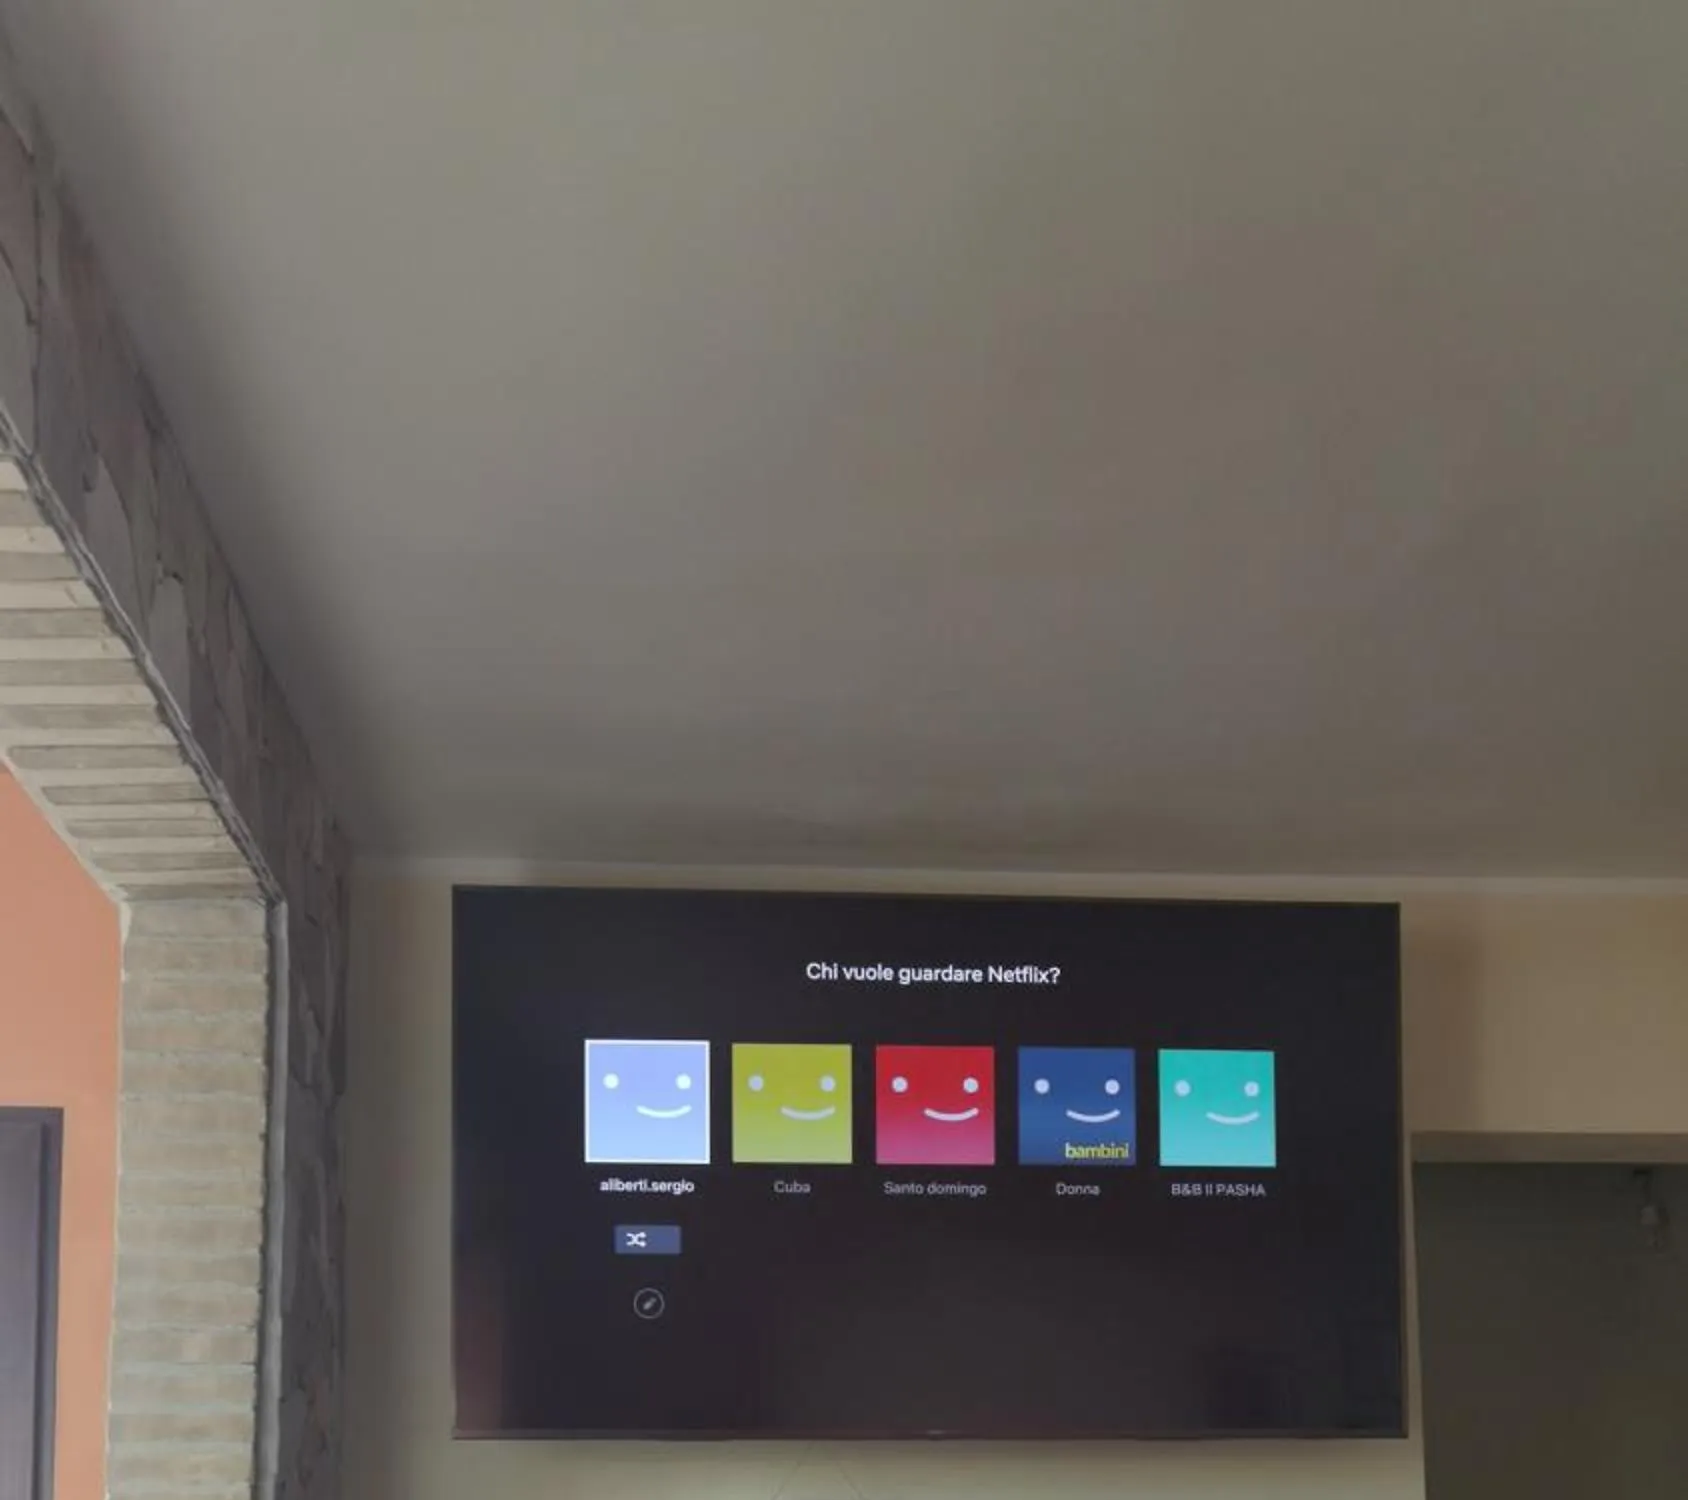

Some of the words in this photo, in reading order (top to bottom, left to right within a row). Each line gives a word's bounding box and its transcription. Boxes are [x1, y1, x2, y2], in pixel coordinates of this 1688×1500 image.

[805, 962, 838, 980] Chi
[843, 963, 894, 981] vuole
[898, 965, 983, 985] guardare
[988, 966, 1061, 984] Netflix?
[1064, 1142, 1129, 1159] bambini
[773, 1180, 811, 1193] Cuba
[883, 1181, 924, 1195] Santo
[926, 1181, 987, 1198] domingo
[1055, 1182, 1101, 1196] Donna
[1171, 1183, 1202, 1196] B&B
[1216, 1183, 1267, 1196] PASHA
